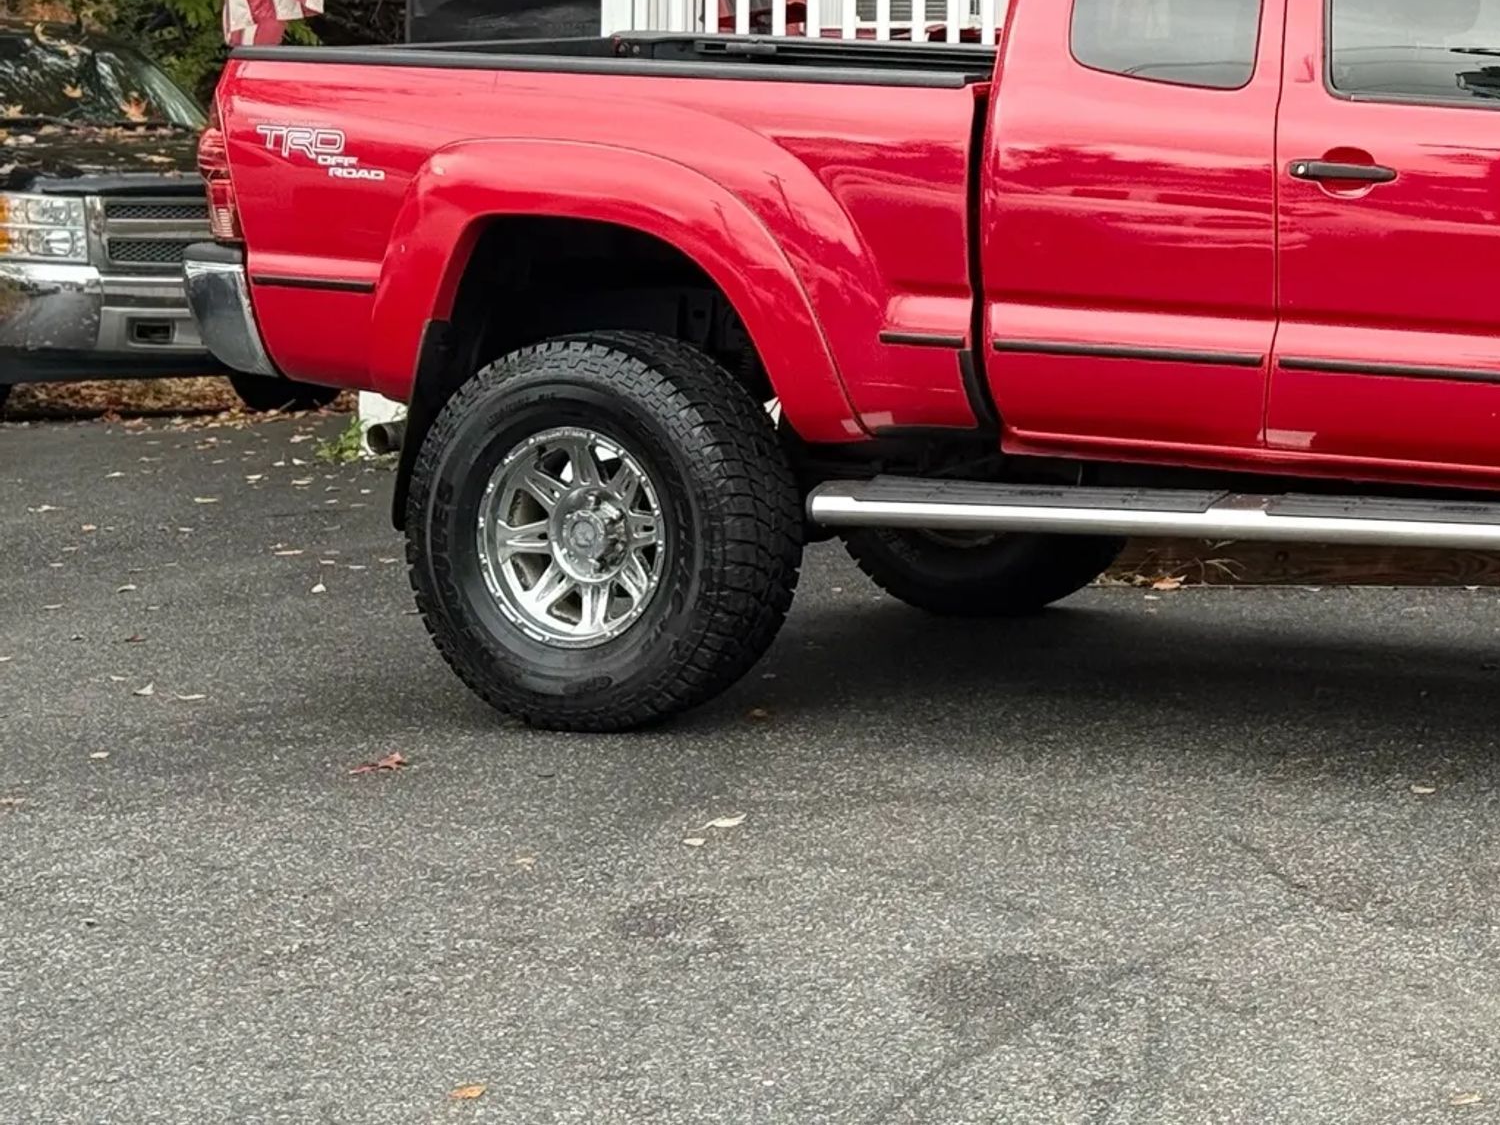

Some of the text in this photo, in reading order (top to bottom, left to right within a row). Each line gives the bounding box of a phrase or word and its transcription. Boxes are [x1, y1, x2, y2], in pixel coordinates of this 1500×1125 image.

[256, 125, 345, 158] TRD
[316, 154, 359, 167] OFF
[328, 166, 385, 181] ROAD
